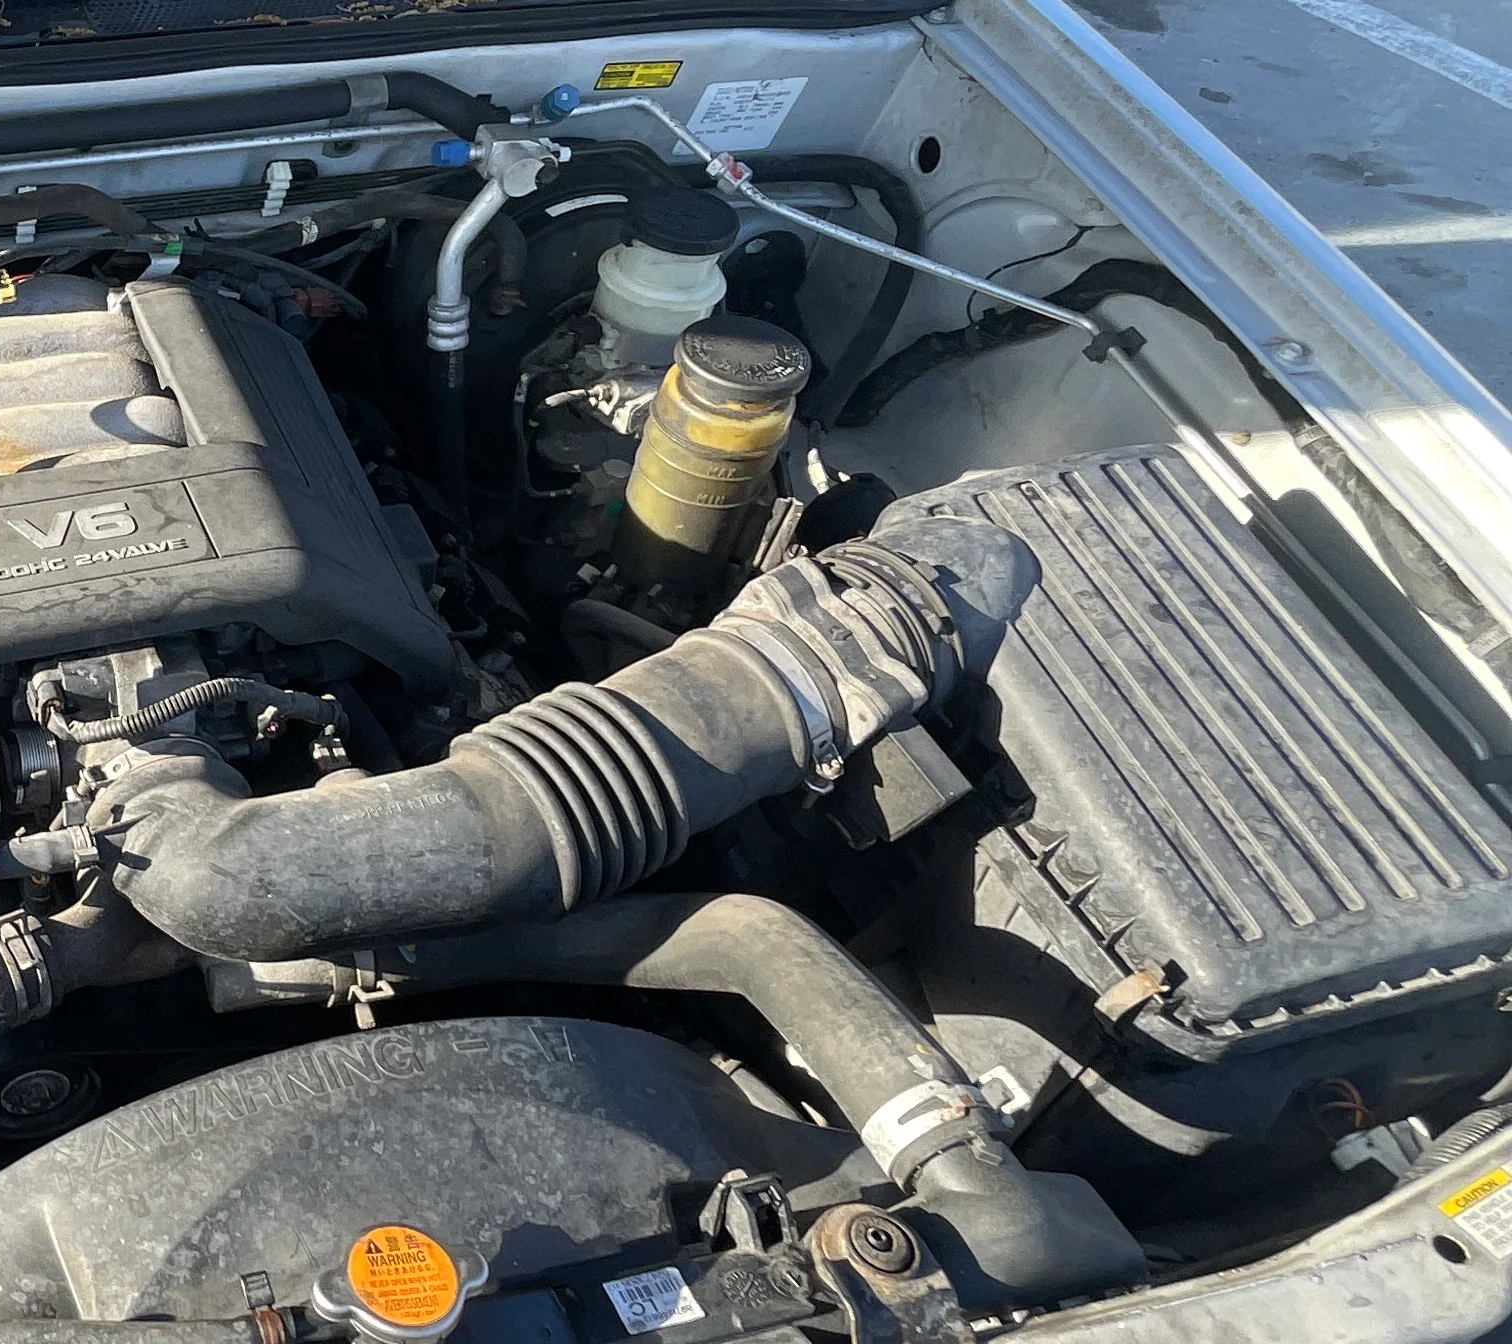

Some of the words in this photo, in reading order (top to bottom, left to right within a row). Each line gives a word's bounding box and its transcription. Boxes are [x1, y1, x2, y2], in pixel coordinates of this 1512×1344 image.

[7, 502, 138, 549] V6
[74, 538, 189, 566] 24VALVE
[142, 1034, 425, 1146] WARNING
[1455, 1178, 1499, 1208] CAUTION
[367, 1251, 427, 1267] WARNING
[628, 1298, 659, 1316] LC
